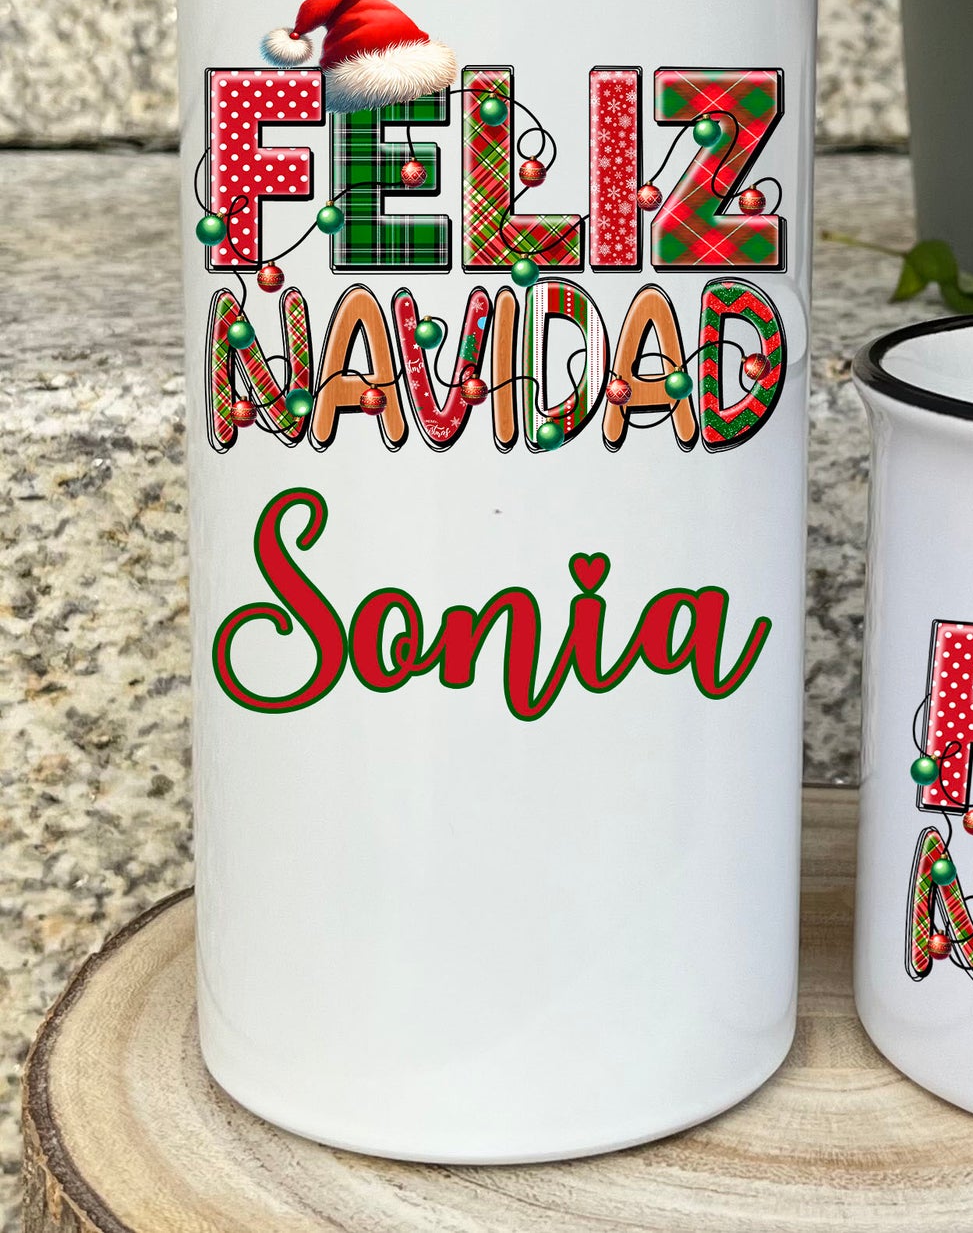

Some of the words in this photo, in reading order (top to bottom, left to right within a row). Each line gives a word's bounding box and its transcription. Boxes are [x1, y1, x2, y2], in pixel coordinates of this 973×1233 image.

[205, 65, 788, 274] FELIZ
[205, 278, 788, 453] NAVIDAD
[212, 487, 772, 722] Sonia
